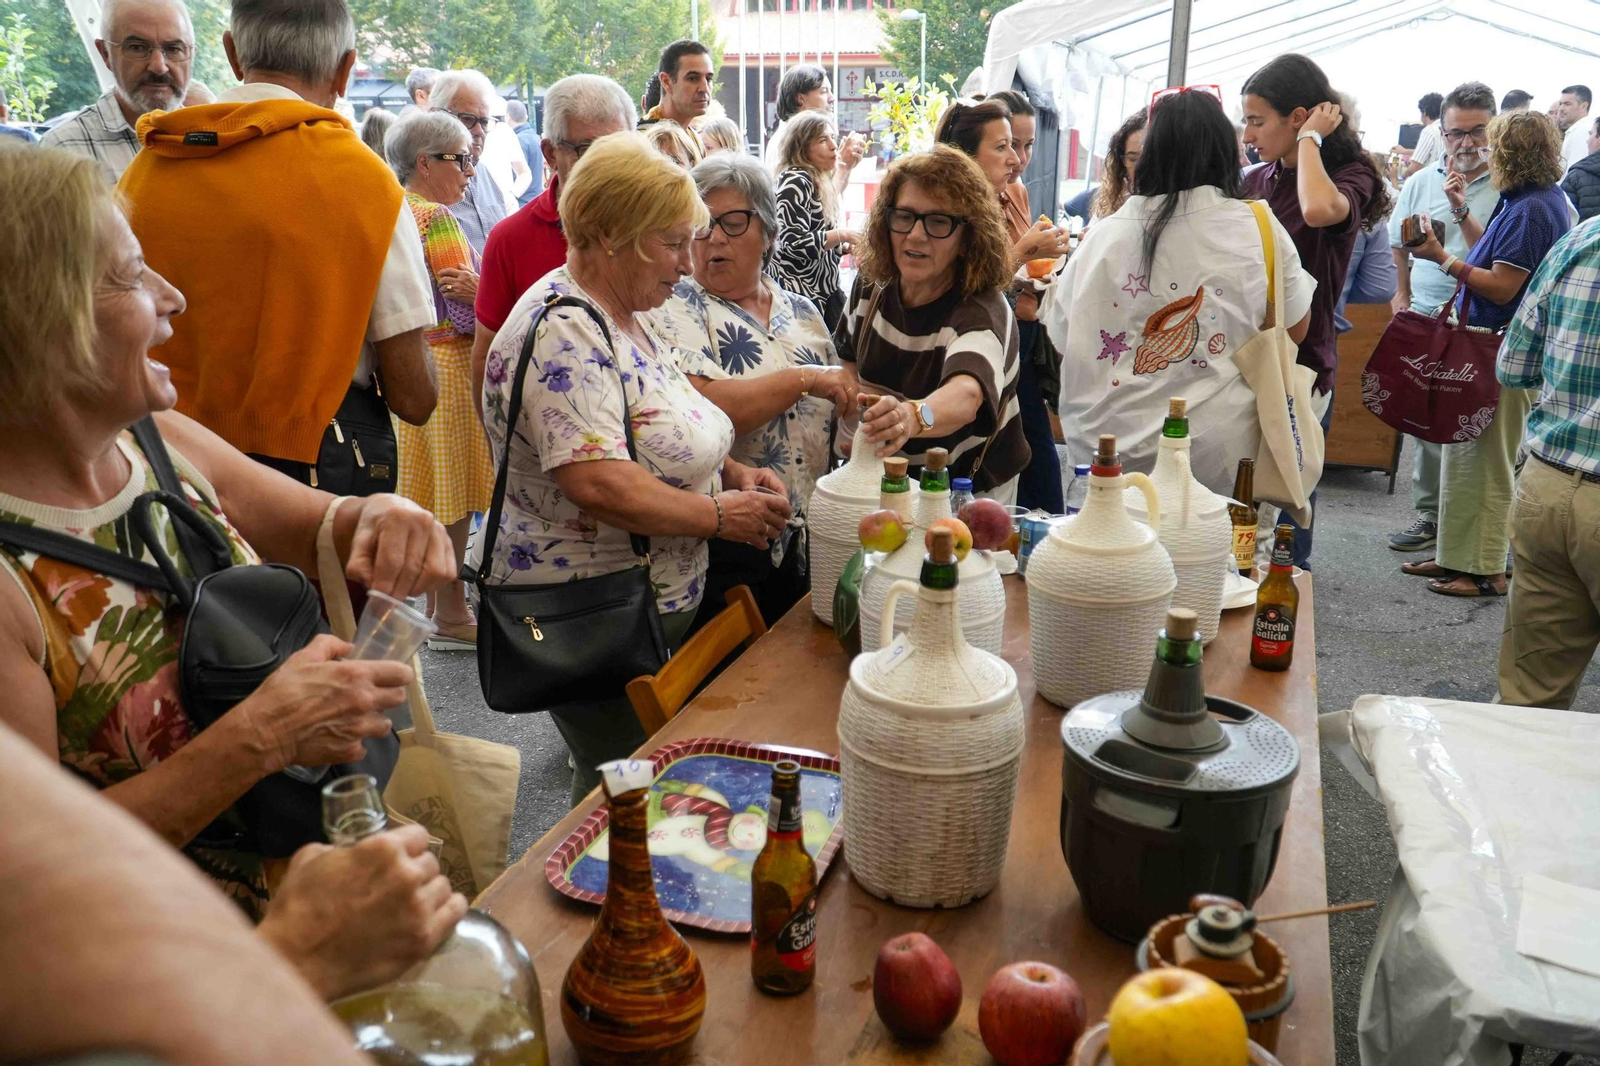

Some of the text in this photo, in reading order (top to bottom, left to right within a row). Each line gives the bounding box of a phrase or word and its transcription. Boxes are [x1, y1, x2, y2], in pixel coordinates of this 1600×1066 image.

[1399, 353, 1428, 371] La
[1256, 617, 1289, 632] Estrella
[1256, 627, 1287, 641] Galicia
